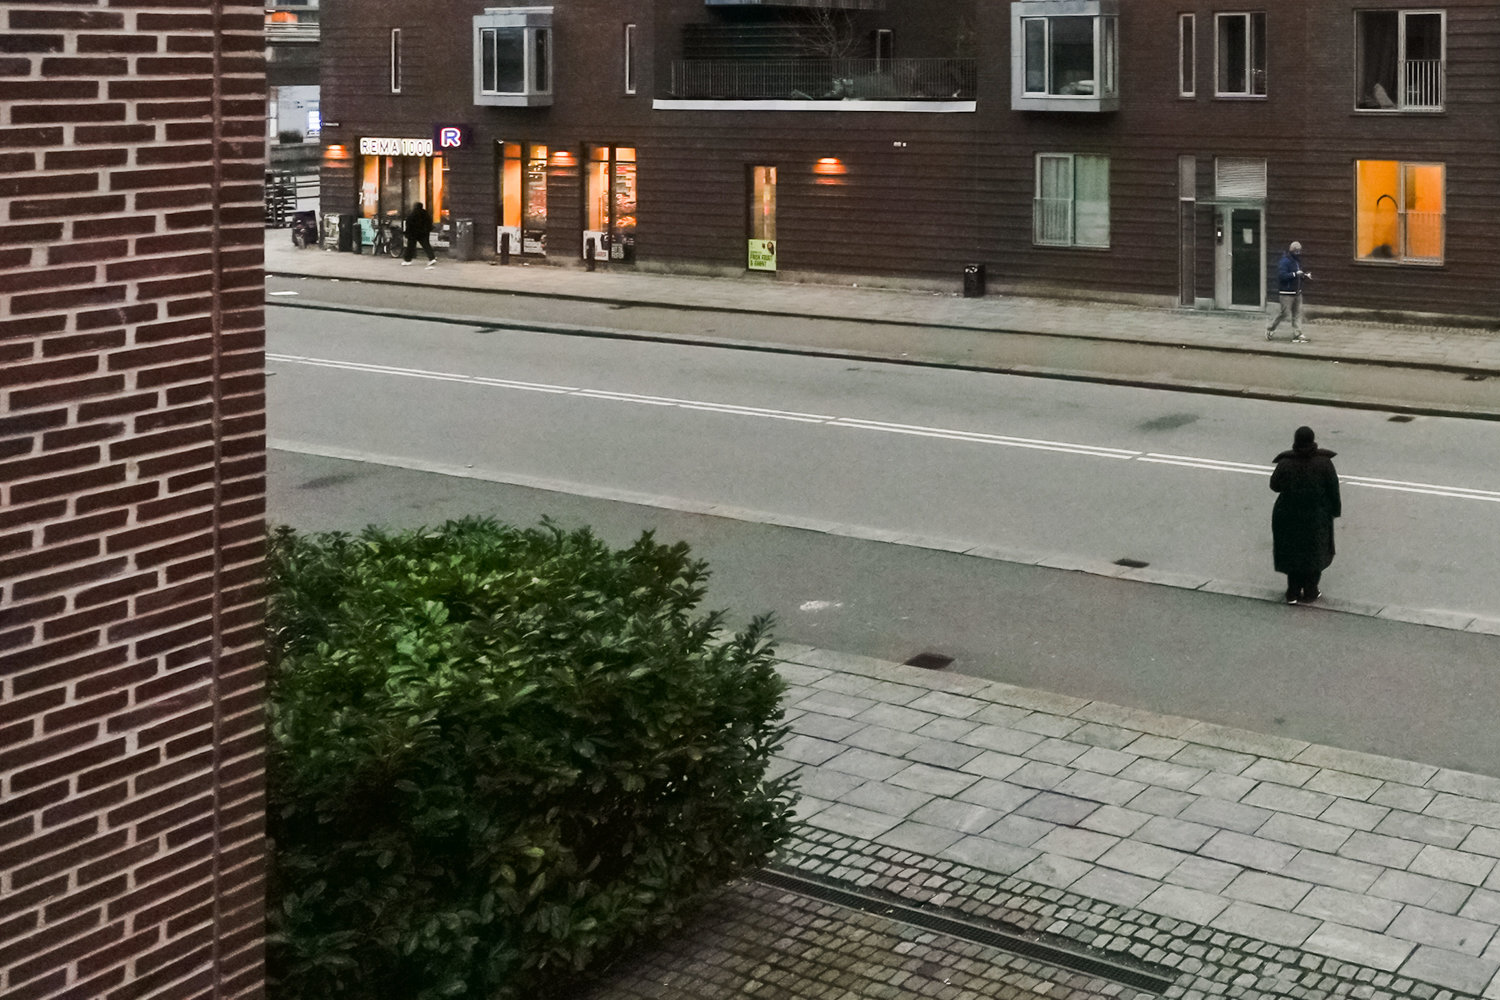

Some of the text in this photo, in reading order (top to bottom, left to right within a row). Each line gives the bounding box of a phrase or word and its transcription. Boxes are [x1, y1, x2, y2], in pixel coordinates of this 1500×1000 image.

[440, 127, 461, 147] R
[360, 138, 433, 157] REMA 1000
